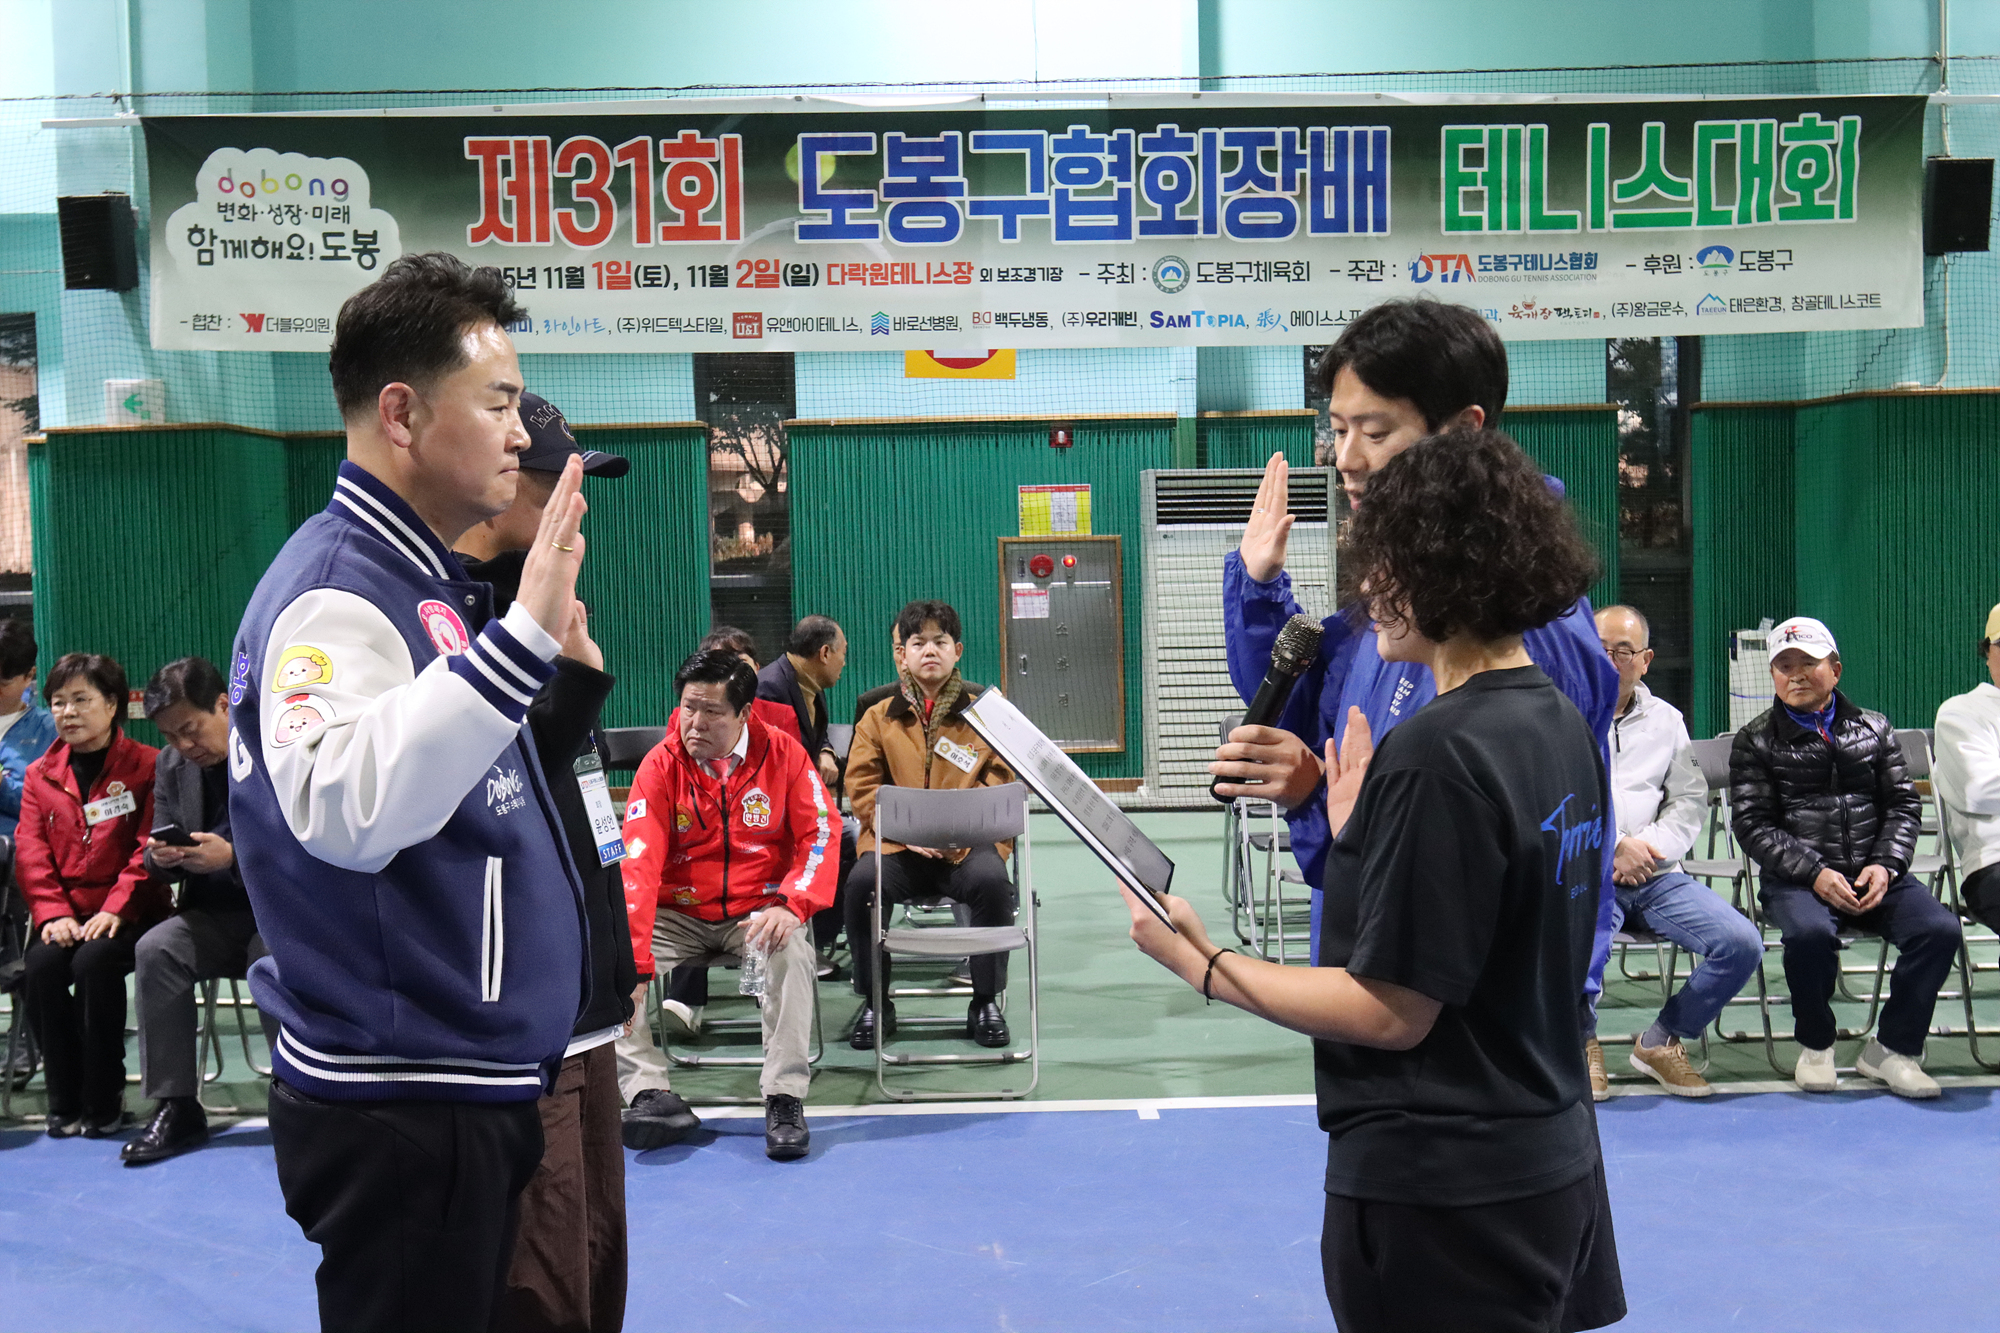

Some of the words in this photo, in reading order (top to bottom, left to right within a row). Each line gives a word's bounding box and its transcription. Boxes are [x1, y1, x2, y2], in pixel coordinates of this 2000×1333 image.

[218, 167, 349, 202] dobong
[465, 129, 744, 248] 제31회
[795, 124, 1391, 246] 도봉구협회장배
[1441, 112, 1861, 236] 테니스대회
[319, 229, 381, 271] 도봉
[1738, 249, 1793, 273] 도봉구
[1196, 260, 1310, 284] 도봉구체육회
[1348, 260, 1386, 282] 주관
[1478, 252, 1598, 272] 도봉구테니스협회
[1643, 254, 1682, 275] 후원
[543, 265, 585, 289] 11월
[687, 264, 729, 288] 11월
[736, 259, 819, 289] 2일(일)
[827, 261, 974, 287] 다락원테니스장
[980, 267, 993, 282] 외
[997, 266, 1064, 283] 보조경기장
[1097, 262, 1135, 285] 주최
[1478, 275, 1509, 283] DOBONG
[1511, 274, 1522, 283] GU
[1524, 274, 1549, 282] TENNIS
[1550, 273, 1597, 282] ASSOCIATION
[1791, 293, 1881, 312] 창골테니스코트
[192, 313, 223, 332] 협찬
[736, 322, 759, 335] U&I
[602, 844, 622, 859] STAFF
